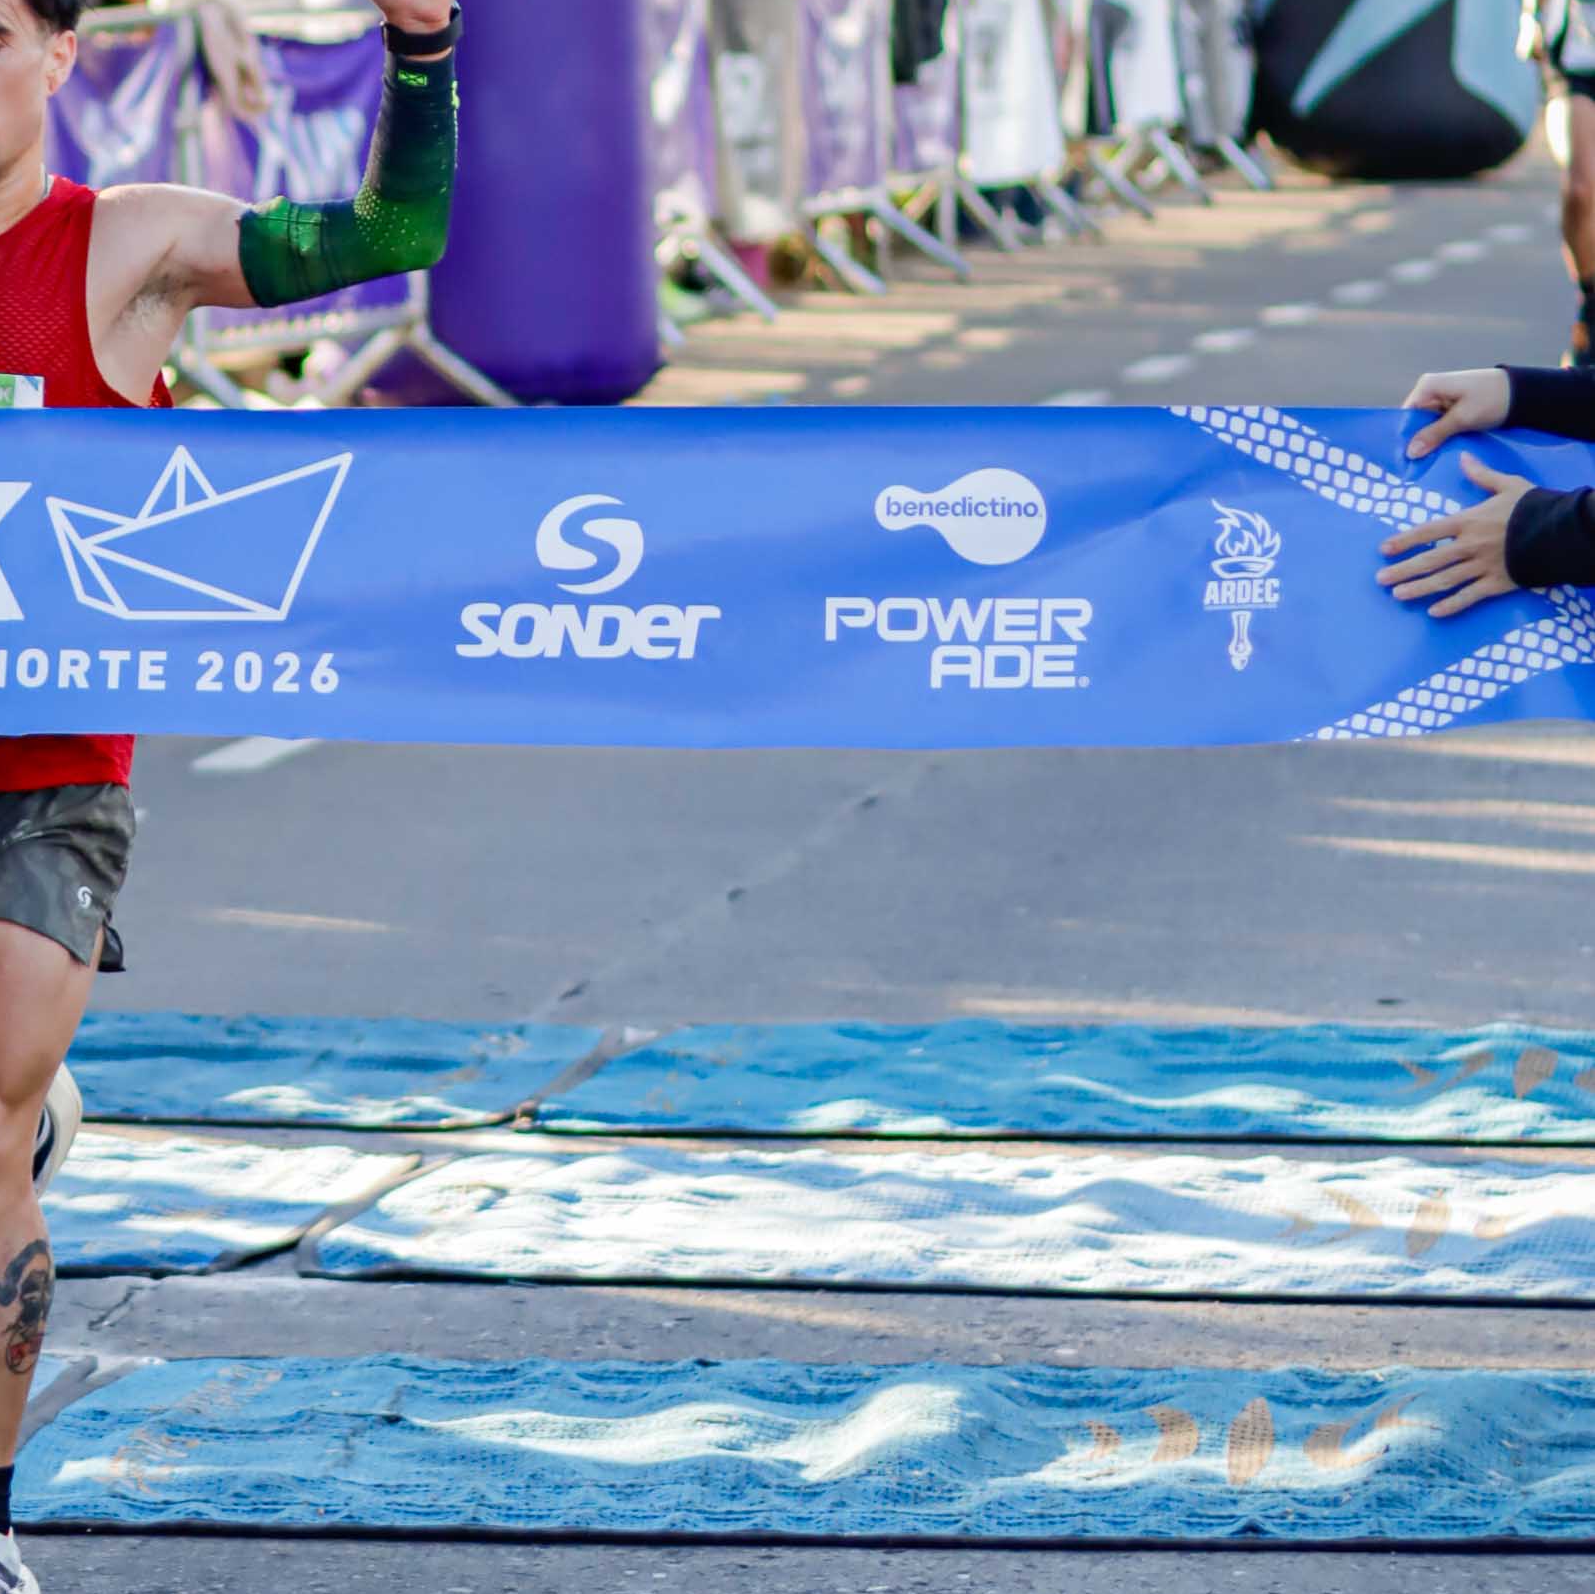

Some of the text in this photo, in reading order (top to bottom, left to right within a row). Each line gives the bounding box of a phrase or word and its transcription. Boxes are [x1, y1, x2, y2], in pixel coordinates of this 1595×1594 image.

[885, 496, 1039, 517] benedictino
[1203, 578, 1280, 605] ARDEC
[824, 597, 1094, 642] POWER
[195, 651, 340, 694] 2026
